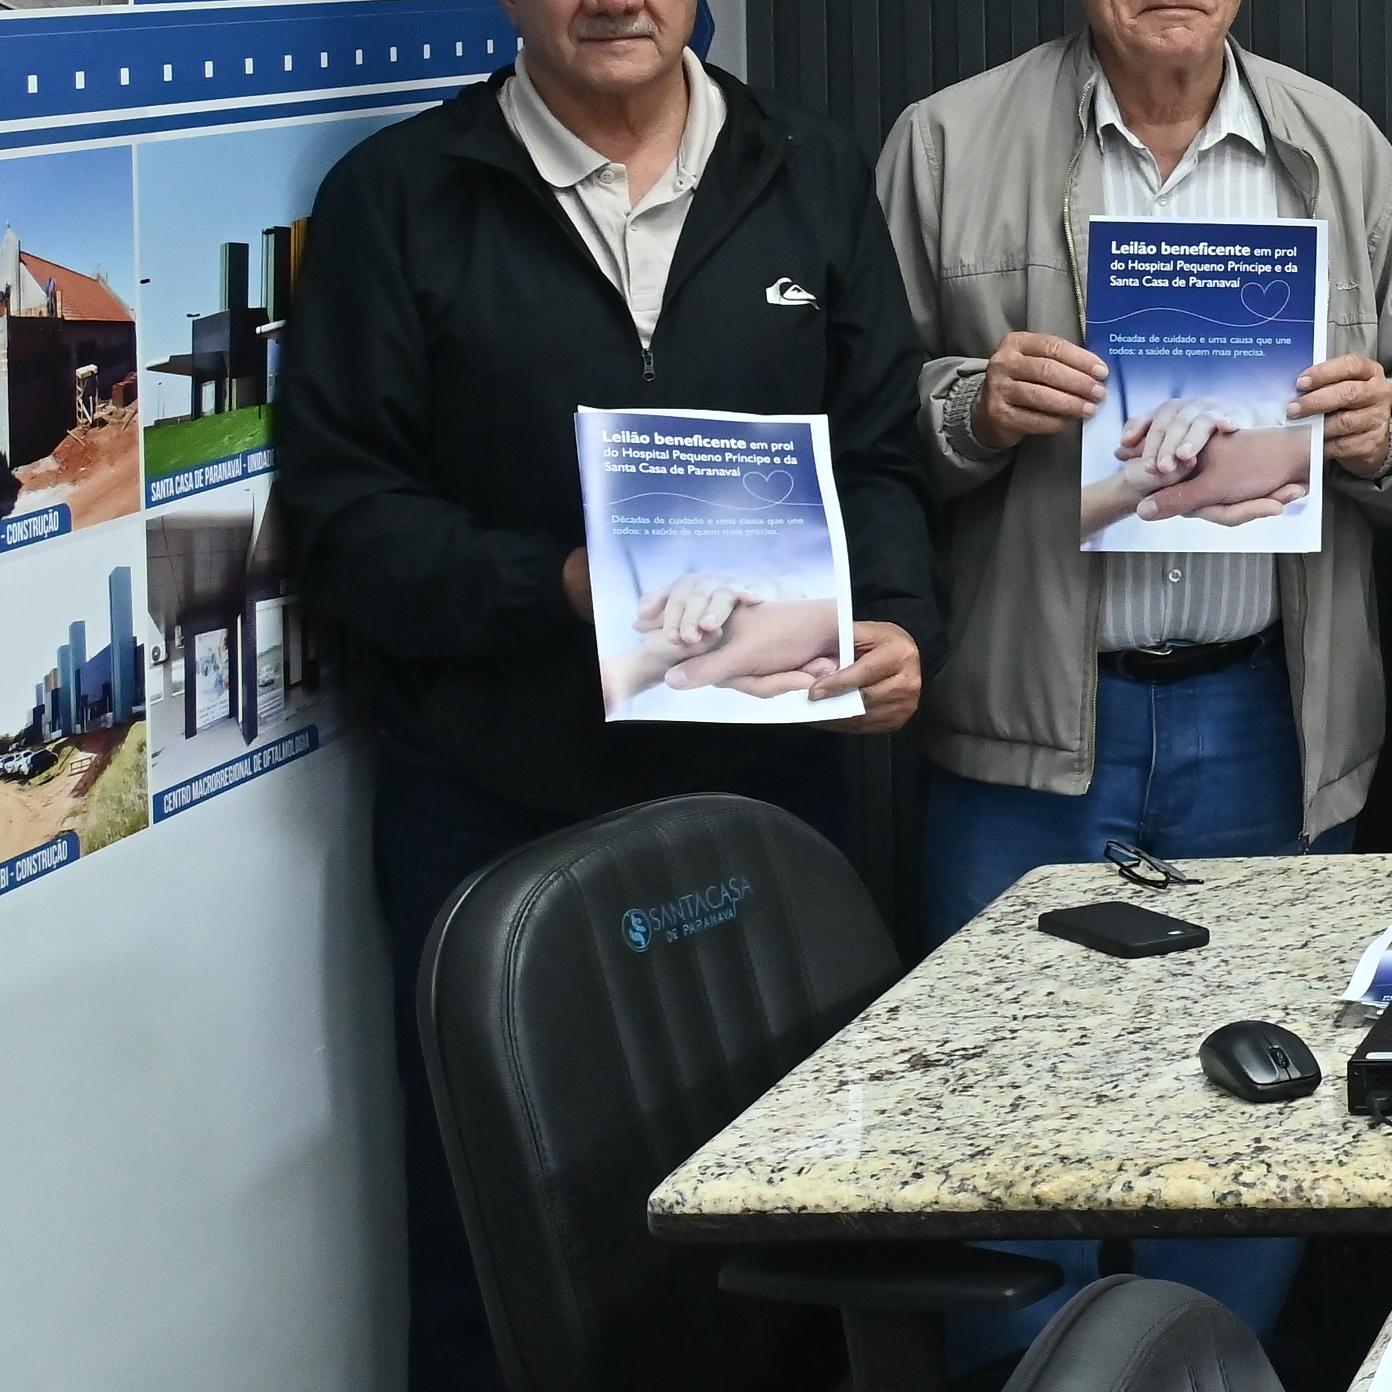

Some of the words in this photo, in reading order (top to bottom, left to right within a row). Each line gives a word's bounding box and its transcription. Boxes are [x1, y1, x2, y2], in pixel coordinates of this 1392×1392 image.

[1111, 241, 1157, 254] Leilão
[1161, 242, 1250, 256] beneficente
[1254, 248, 1271, 256] em
[1275, 246, 1297, 259] prol
[1110, 260, 1125, 270] do
[1128, 260, 1173, 273] Hospital
[1177, 261, 1224, 274] Pequeno
[1228, 261, 1272, 275] Príncipe
[1284, 262, 1298, 272] da
[1110, 275, 1139, 286] Santa
[1142, 276, 1169, 287] Casa
[1172, 276, 1186, 287] de
[1189, 276, 1240, 288] Paranavaí
[1110, 334, 1146, 343] Décadas
[1149, 334, 1160, 343] de
[1163, 335, 1196, 343] cuidado
[1256, 338, 1273, 346] que
[1109, 347, 1136, 355] todos:
[1145, 347, 1170, 355] saúde
[1172, 347, 1183, 355] de
[1185, 349, 1210, 357] quem
[1234, 349, 1266, 358] precisa.
[602, 431, 650, 445] Leilão
[654, 434, 746, 449] beneficente
[771, 441, 794, 452] prol
[602, 448, 619, 458] do
[622, 449, 669, 461] Hospital
[673, 450, 722, 463] Pequeno
[725, 452, 771, 465] Príncipe
[773, 456, 781, 464] e
[784, 455, 798, 464] da
[151, 477, 174, 501] SANTA
[175, 472, 194, 495] CASA
[195, 468, 204, 488] DE
[205, 453, 243, 486] PARANAVAÍ
[604, 462, 636, 472] Santa
[639, 463, 667, 474] Casa
[670, 465, 684, 474] de
[687, 465, 740, 476] Paranavaí
[6, 509, 59, 545] CONSTRUÇÃO
[163, 782, 191, 813] CENTRO
[192, 760, 252, 801] MACRORREGIONAL
[253, 753, 263, 774] DE
[16, 839, 68, 881] CONSTRUÇÃO
